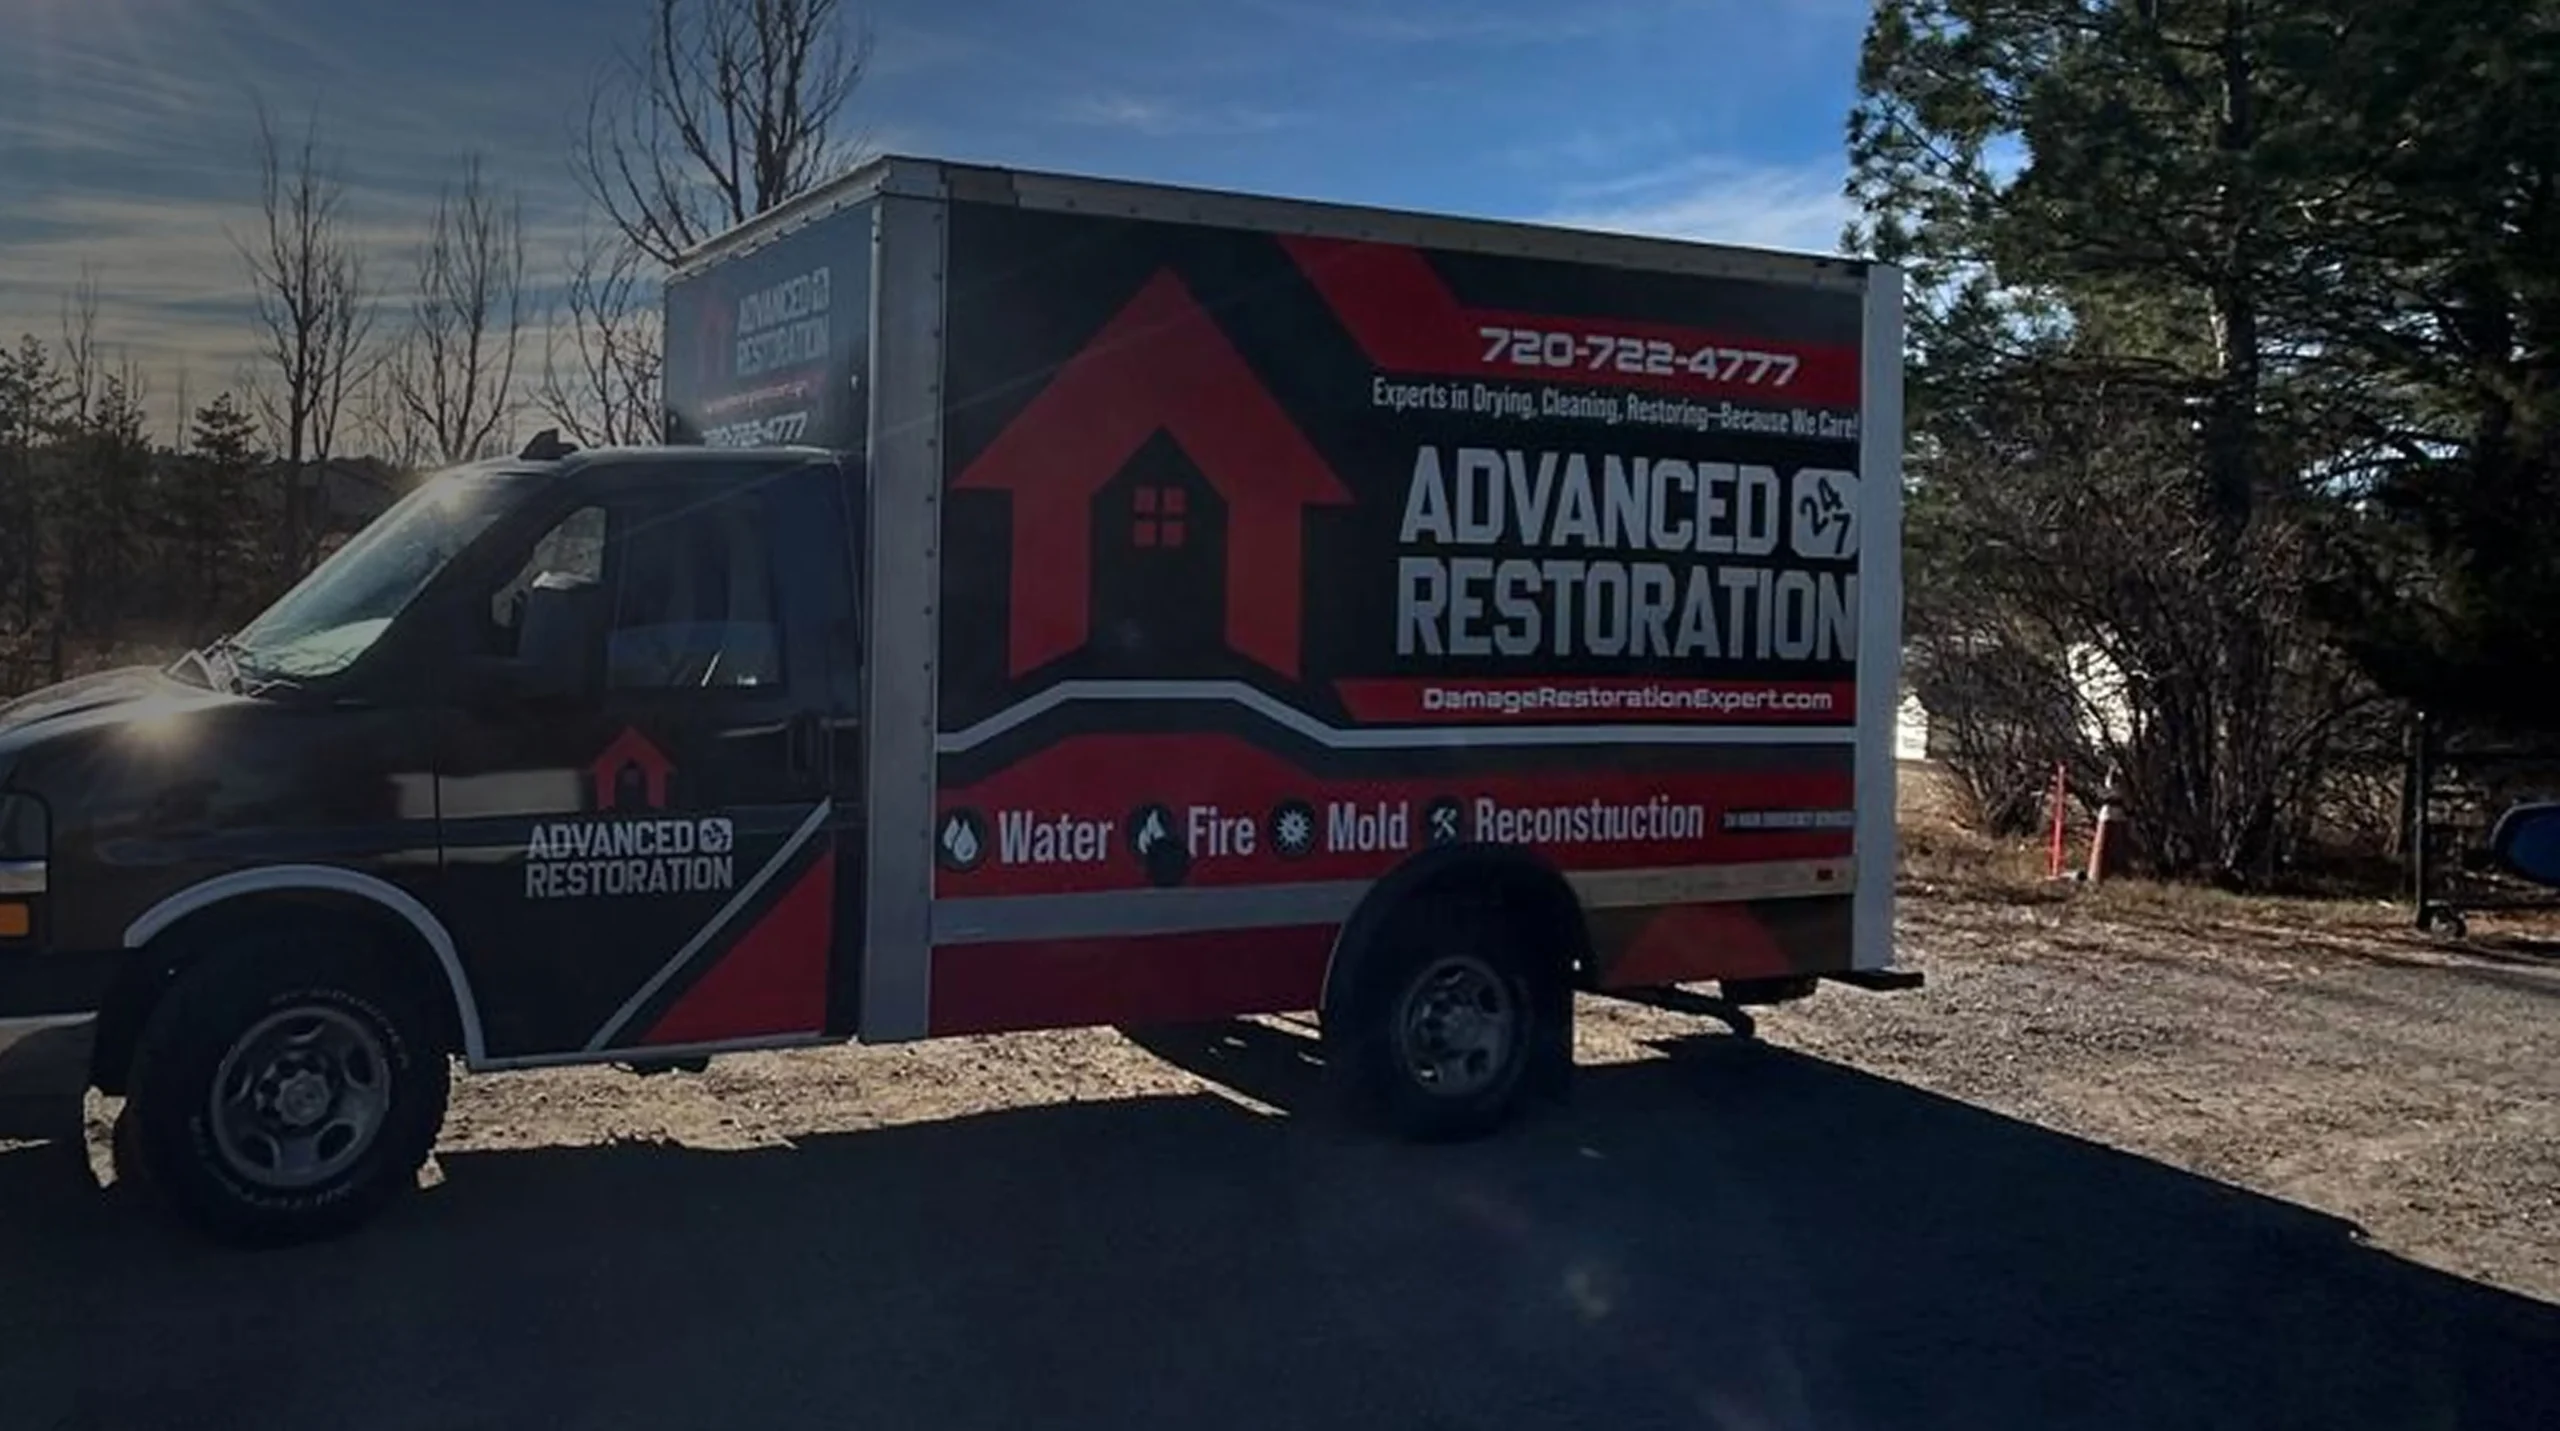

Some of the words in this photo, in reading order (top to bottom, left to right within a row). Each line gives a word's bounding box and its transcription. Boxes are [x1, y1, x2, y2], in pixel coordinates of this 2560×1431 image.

[1479, 327, 1799, 387] 720-722-4777
[1372, 376, 1449, 413] Experts
[1450, 382, 1468, 410] in
[1473, 383, 1539, 420] Drying,
[1542, 386, 1624, 426] Cleaning,
[1791, 407, 1816, 436] We
[1400, 444, 1781, 557] ADVANCED
[1396, 556, 1858, 661] RESTORATION
[1423, 685, 1832, 713] DamageRestorationExpert.com
[527, 820, 695, 860] ADVANCED
[998, 810, 1113, 864] Water
[1188, 805, 1257, 857] Fire
[1328, 800, 1409, 852] Mold
[1475, 795, 1705, 844] Reconstruction
[525, 855, 733, 899] RESTORATION
